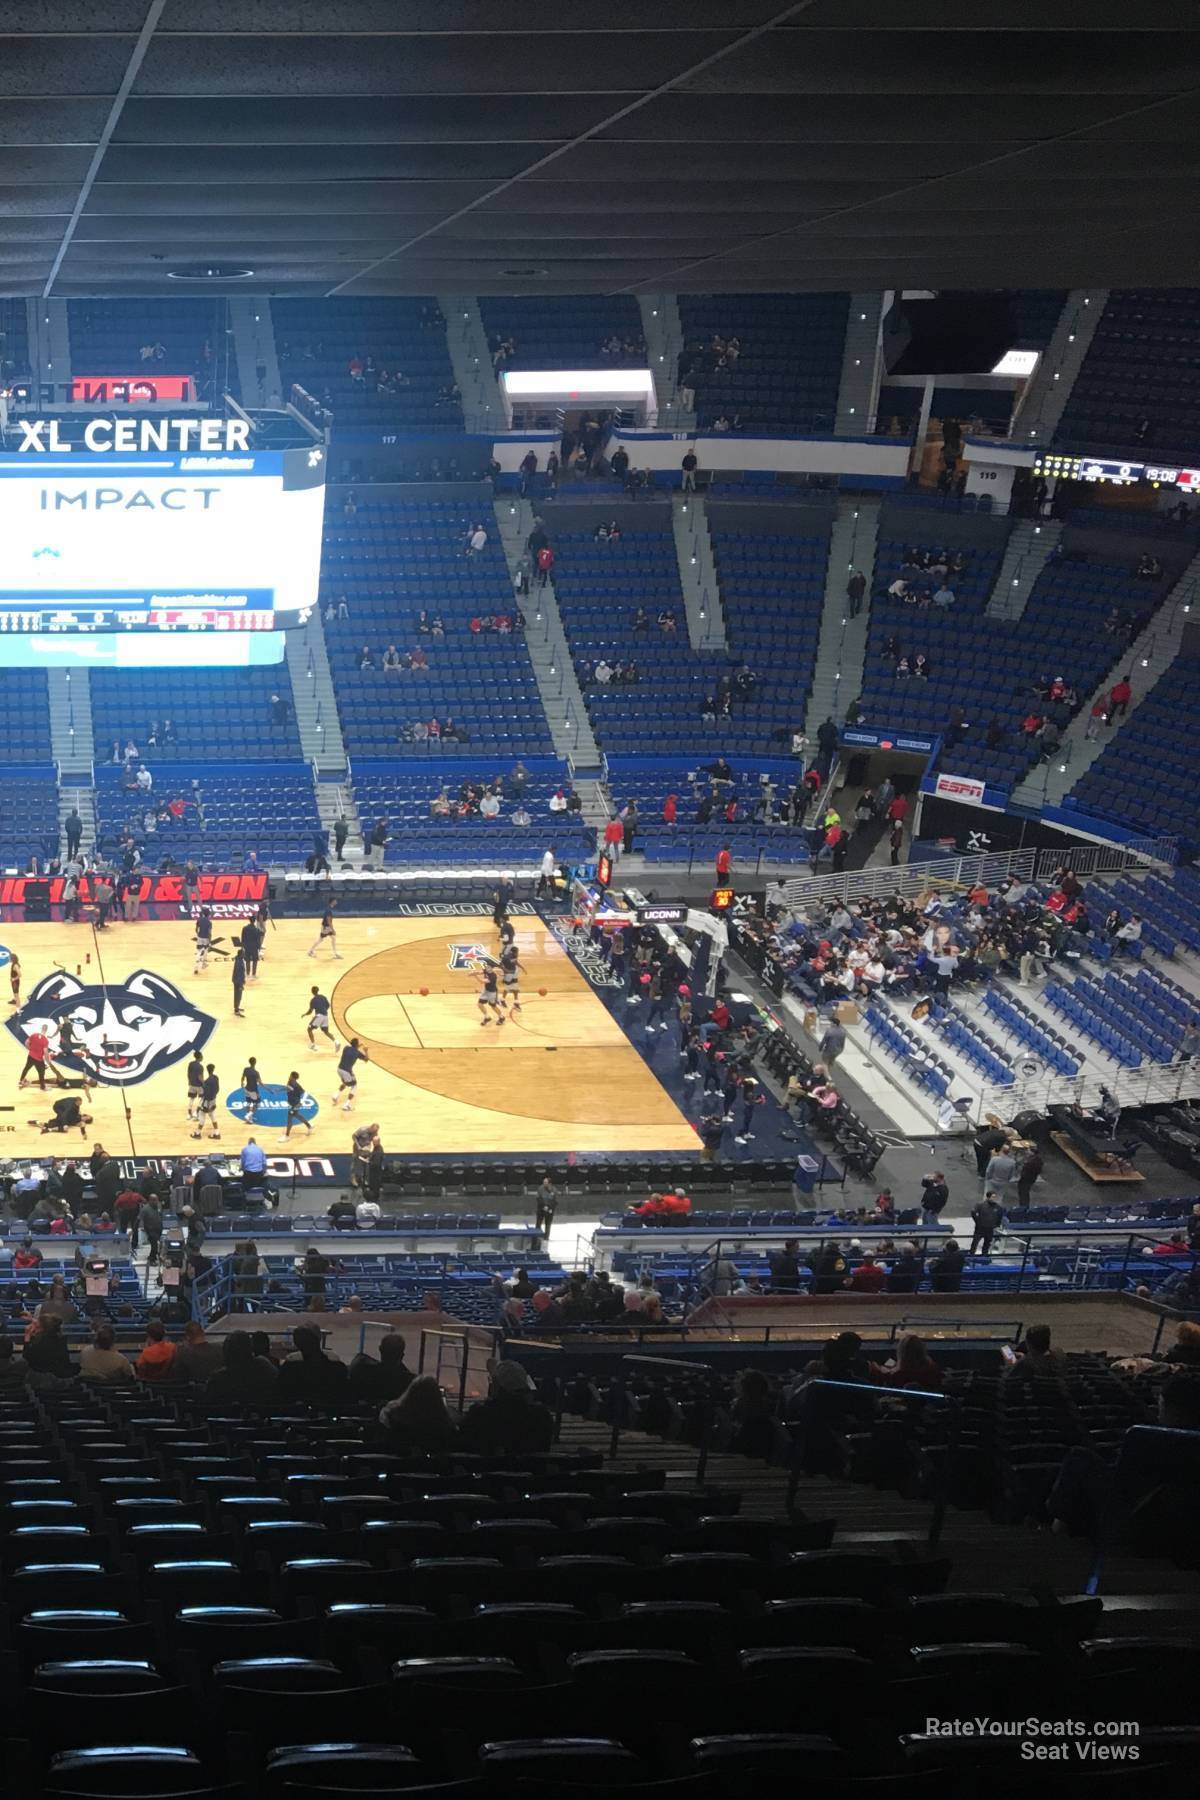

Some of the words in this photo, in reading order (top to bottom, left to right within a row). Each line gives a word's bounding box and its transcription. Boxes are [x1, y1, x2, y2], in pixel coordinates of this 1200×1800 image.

[18, 420, 72, 452] XL
[84, 419, 250, 452] CENTER
[980, 472, 997, 480] 119
[1146, 469, 1177, 483] 19:08
[40, 488, 221, 510] IMPACT
[938, 779, 982, 797] ESPN
[968, 831, 991, 847] XL
[733, 895, 757, 911] XL
[644, 910, 681, 919] UCONN
